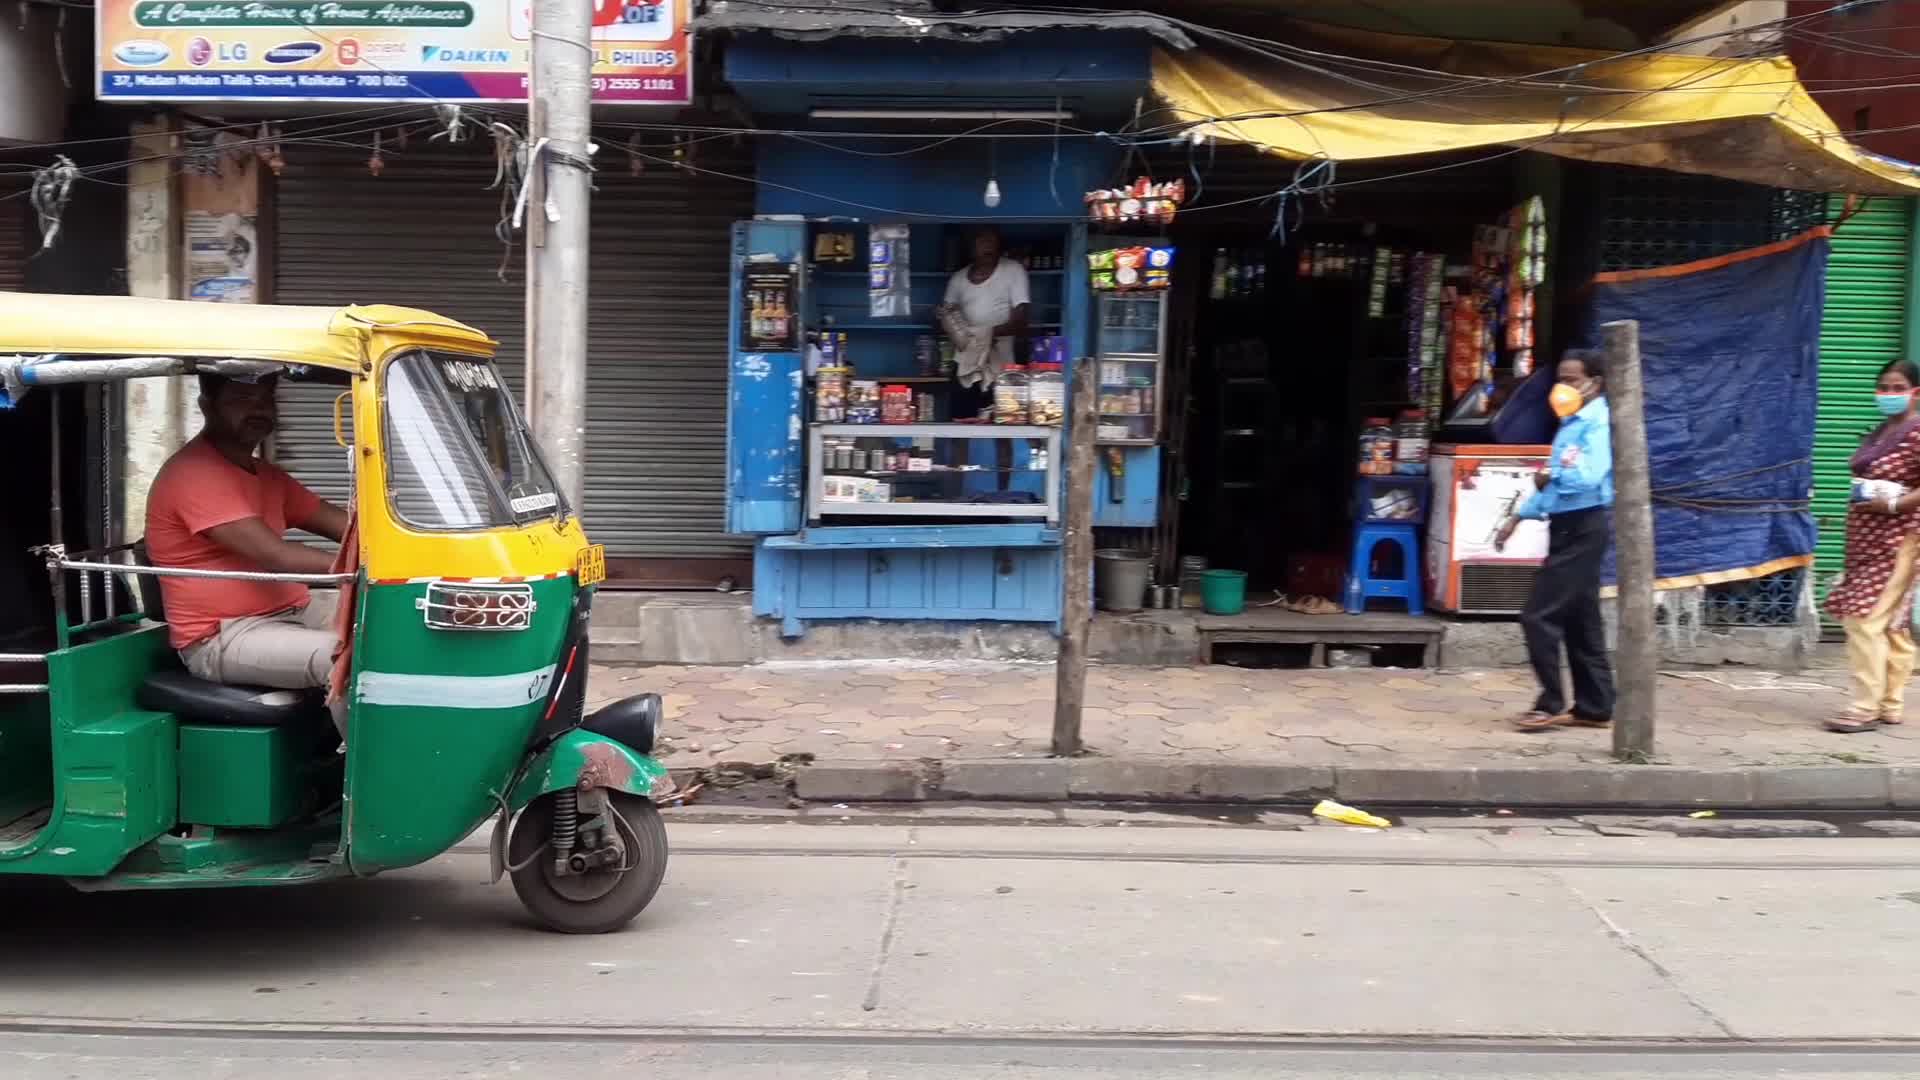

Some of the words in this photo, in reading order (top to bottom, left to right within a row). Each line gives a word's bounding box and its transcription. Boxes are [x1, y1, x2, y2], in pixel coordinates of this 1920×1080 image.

[142, 4, 165, 20] A
[167, 3, 241, 22] Complete
[243, 3, 296, 20] House
[299, 4, 320, 23] of
[320, 3, 369, 20] Home
[371, 3, 466, 22] Appliances
[622, 6, 664, 25] OFF
[218, 43, 249, 61] LG
[439, 49, 509, 63] DAIKIN
[613, 51, 675, 65] PHILIPS
[111, 75, 134, 88] 37,
[135, 75, 177, 87] Madan
[177, 75, 221, 87] Mohan
[253, 75, 296, 88] Street,
[298, 75, 347, 87] Kolkata
[356, 76, 382, 87] 700
[607, 79, 641, 90] 2555
